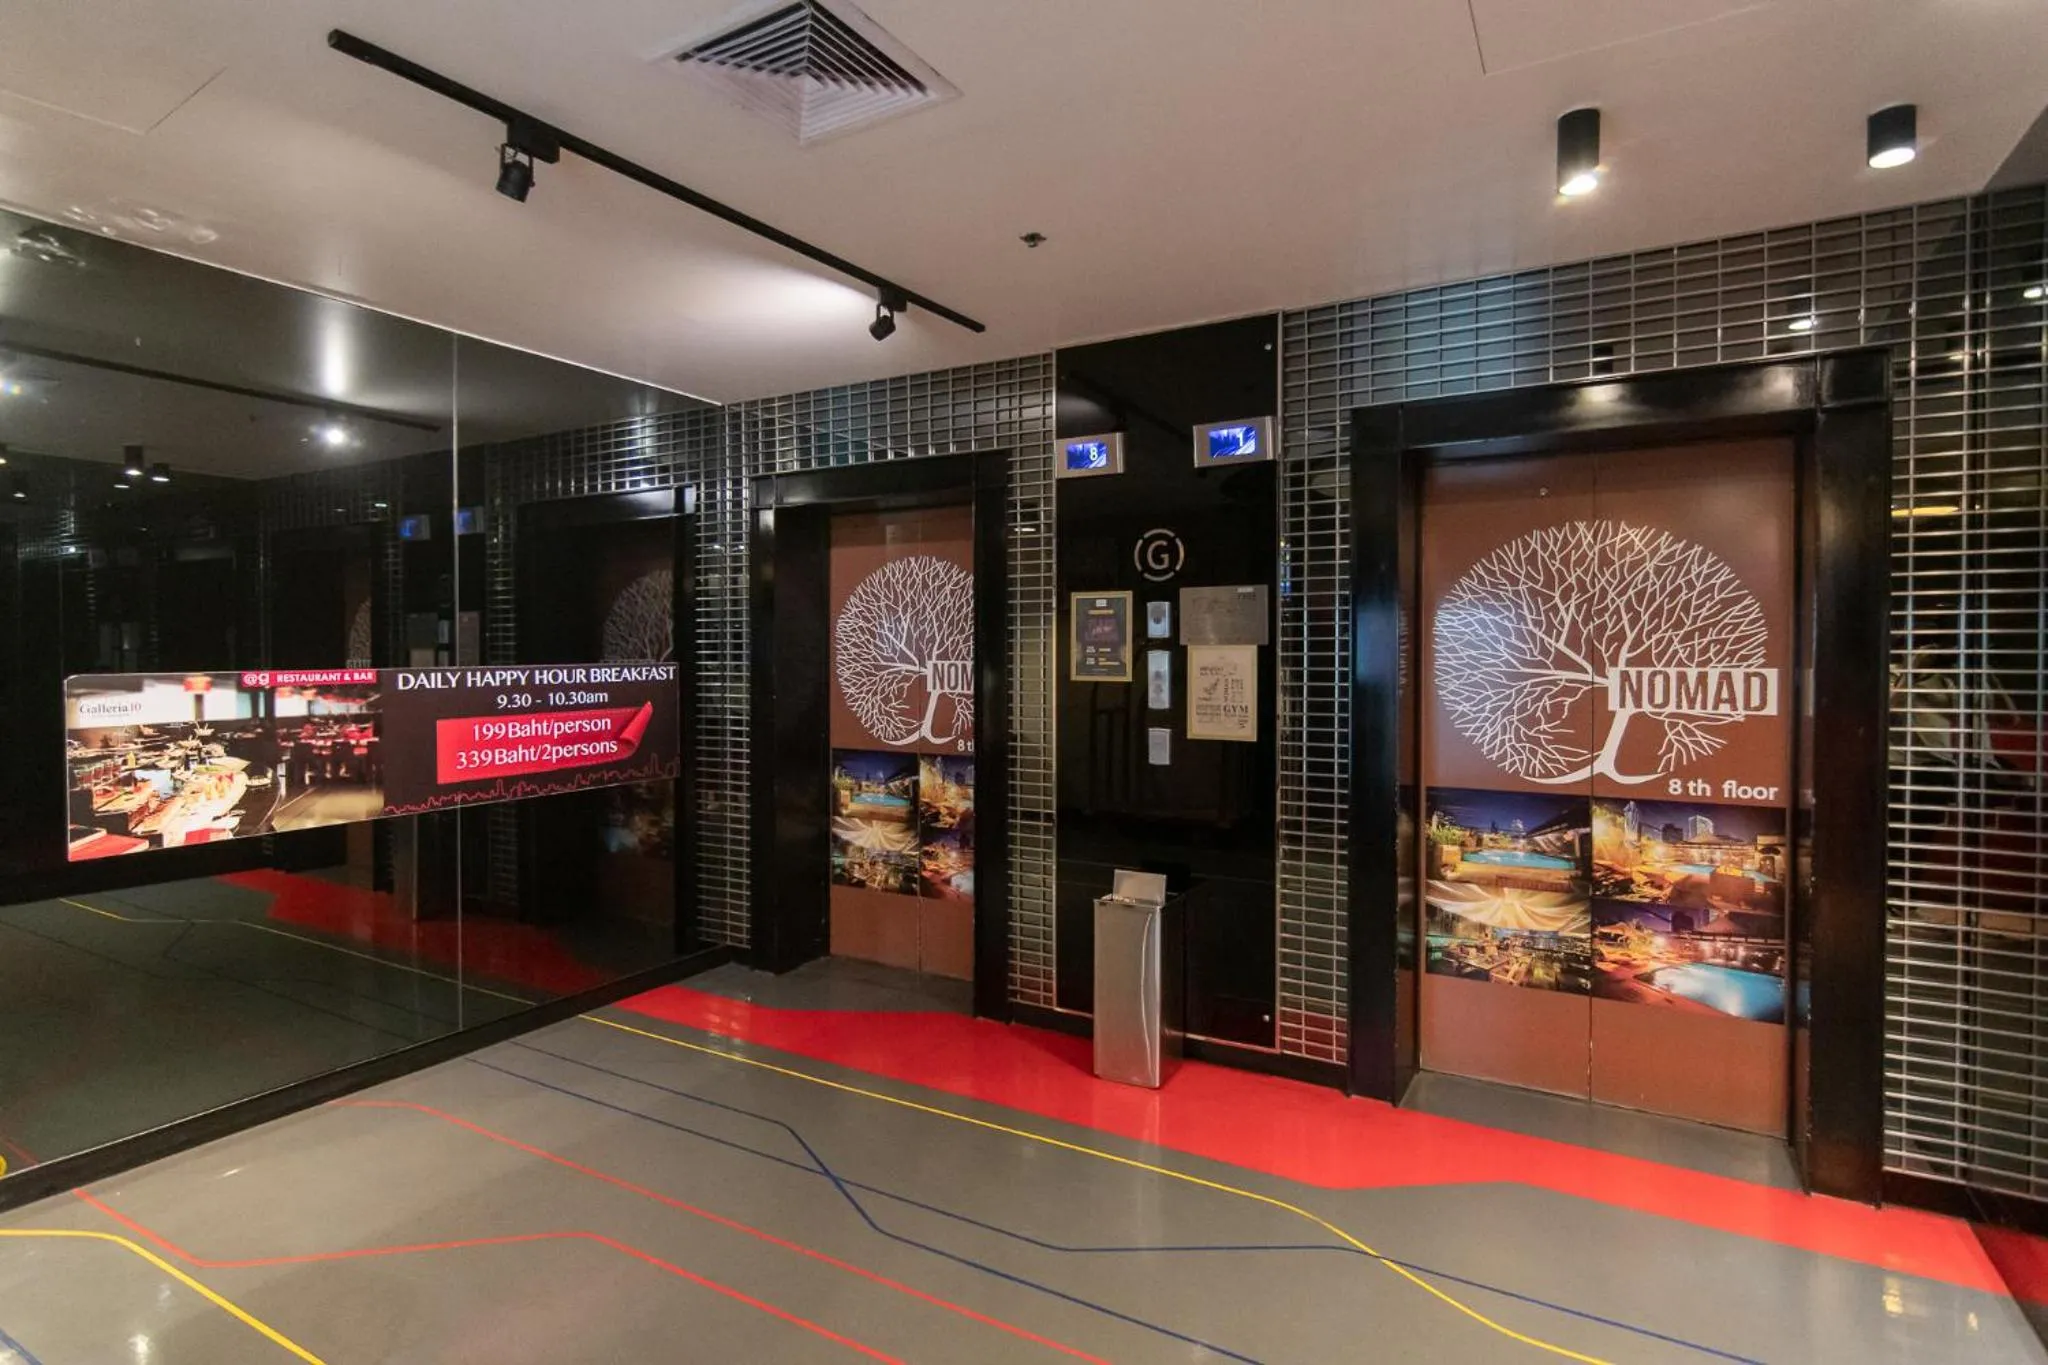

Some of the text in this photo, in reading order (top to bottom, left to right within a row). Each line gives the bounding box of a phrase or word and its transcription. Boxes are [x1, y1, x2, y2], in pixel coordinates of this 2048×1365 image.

[1089, 447, 1098, 461] 8
[1147, 540, 1169, 569] G
[276, 672, 342, 683] RESTAURANT
[343, 672, 351, 681] &
[353, 671, 373, 681] BAR
[398, 665, 676, 690] DAILY HAPPY HOUR BREAKFAST
[932, 662, 974, 691] NOM
[497, 693, 532, 709] 9.30
[548, 689, 608, 706] 10.30am
[1618, 669, 1769, 713] NOMAD
[957, 739, 965, 752] 8
[1668, 778, 1779, 800] 8 th floor
